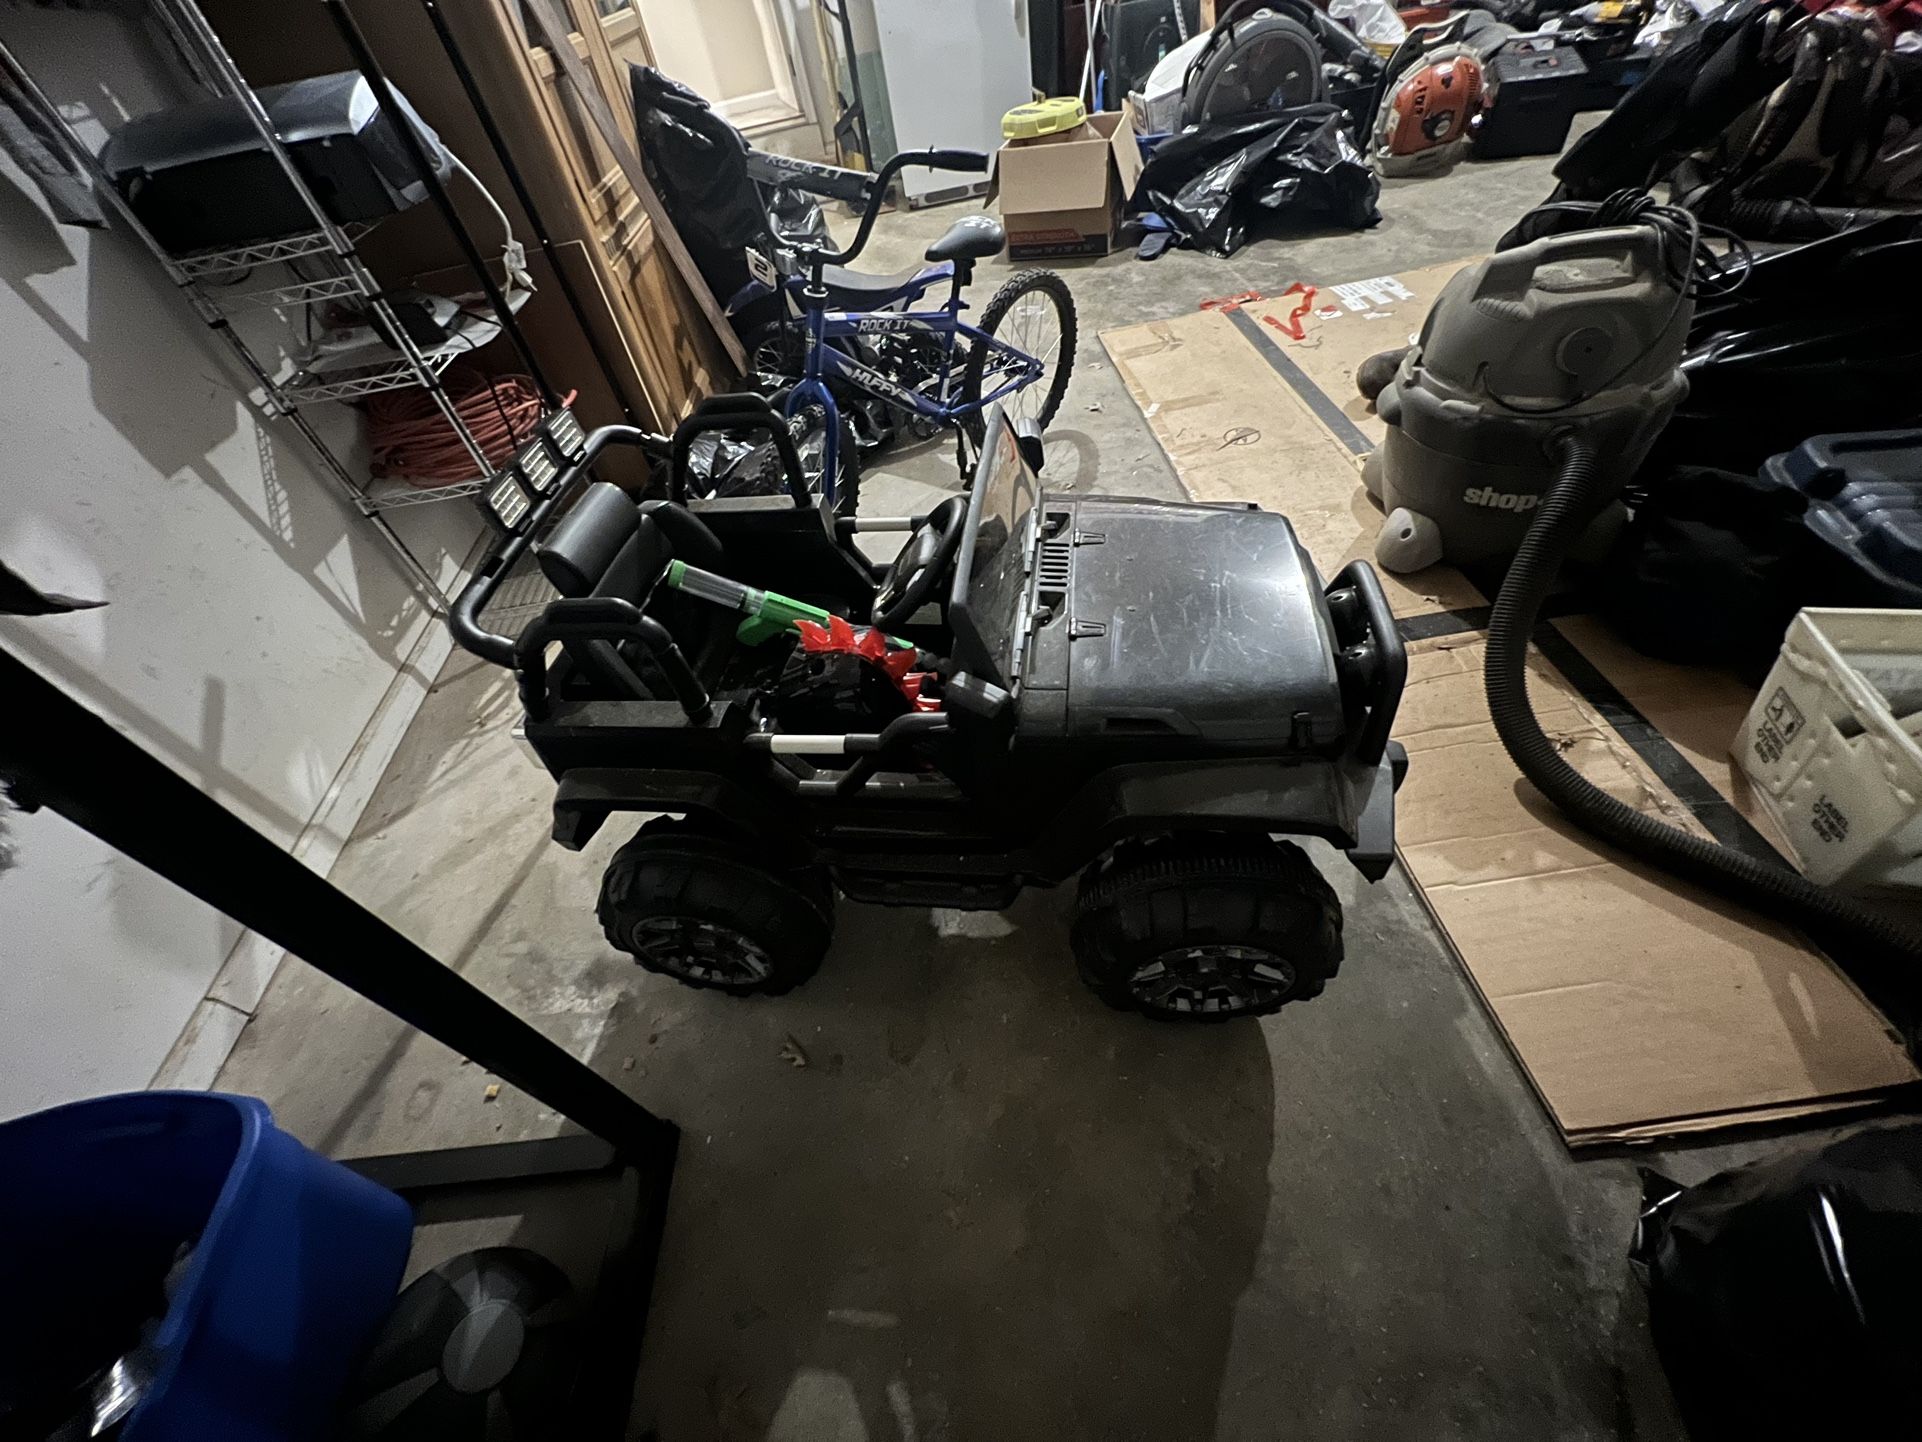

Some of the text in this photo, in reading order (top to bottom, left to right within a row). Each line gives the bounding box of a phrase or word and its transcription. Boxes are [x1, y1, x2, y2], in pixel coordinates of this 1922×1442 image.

[859, 319, 911, 332] ROCK IT
[851, 368, 901, 396] HUFFY
